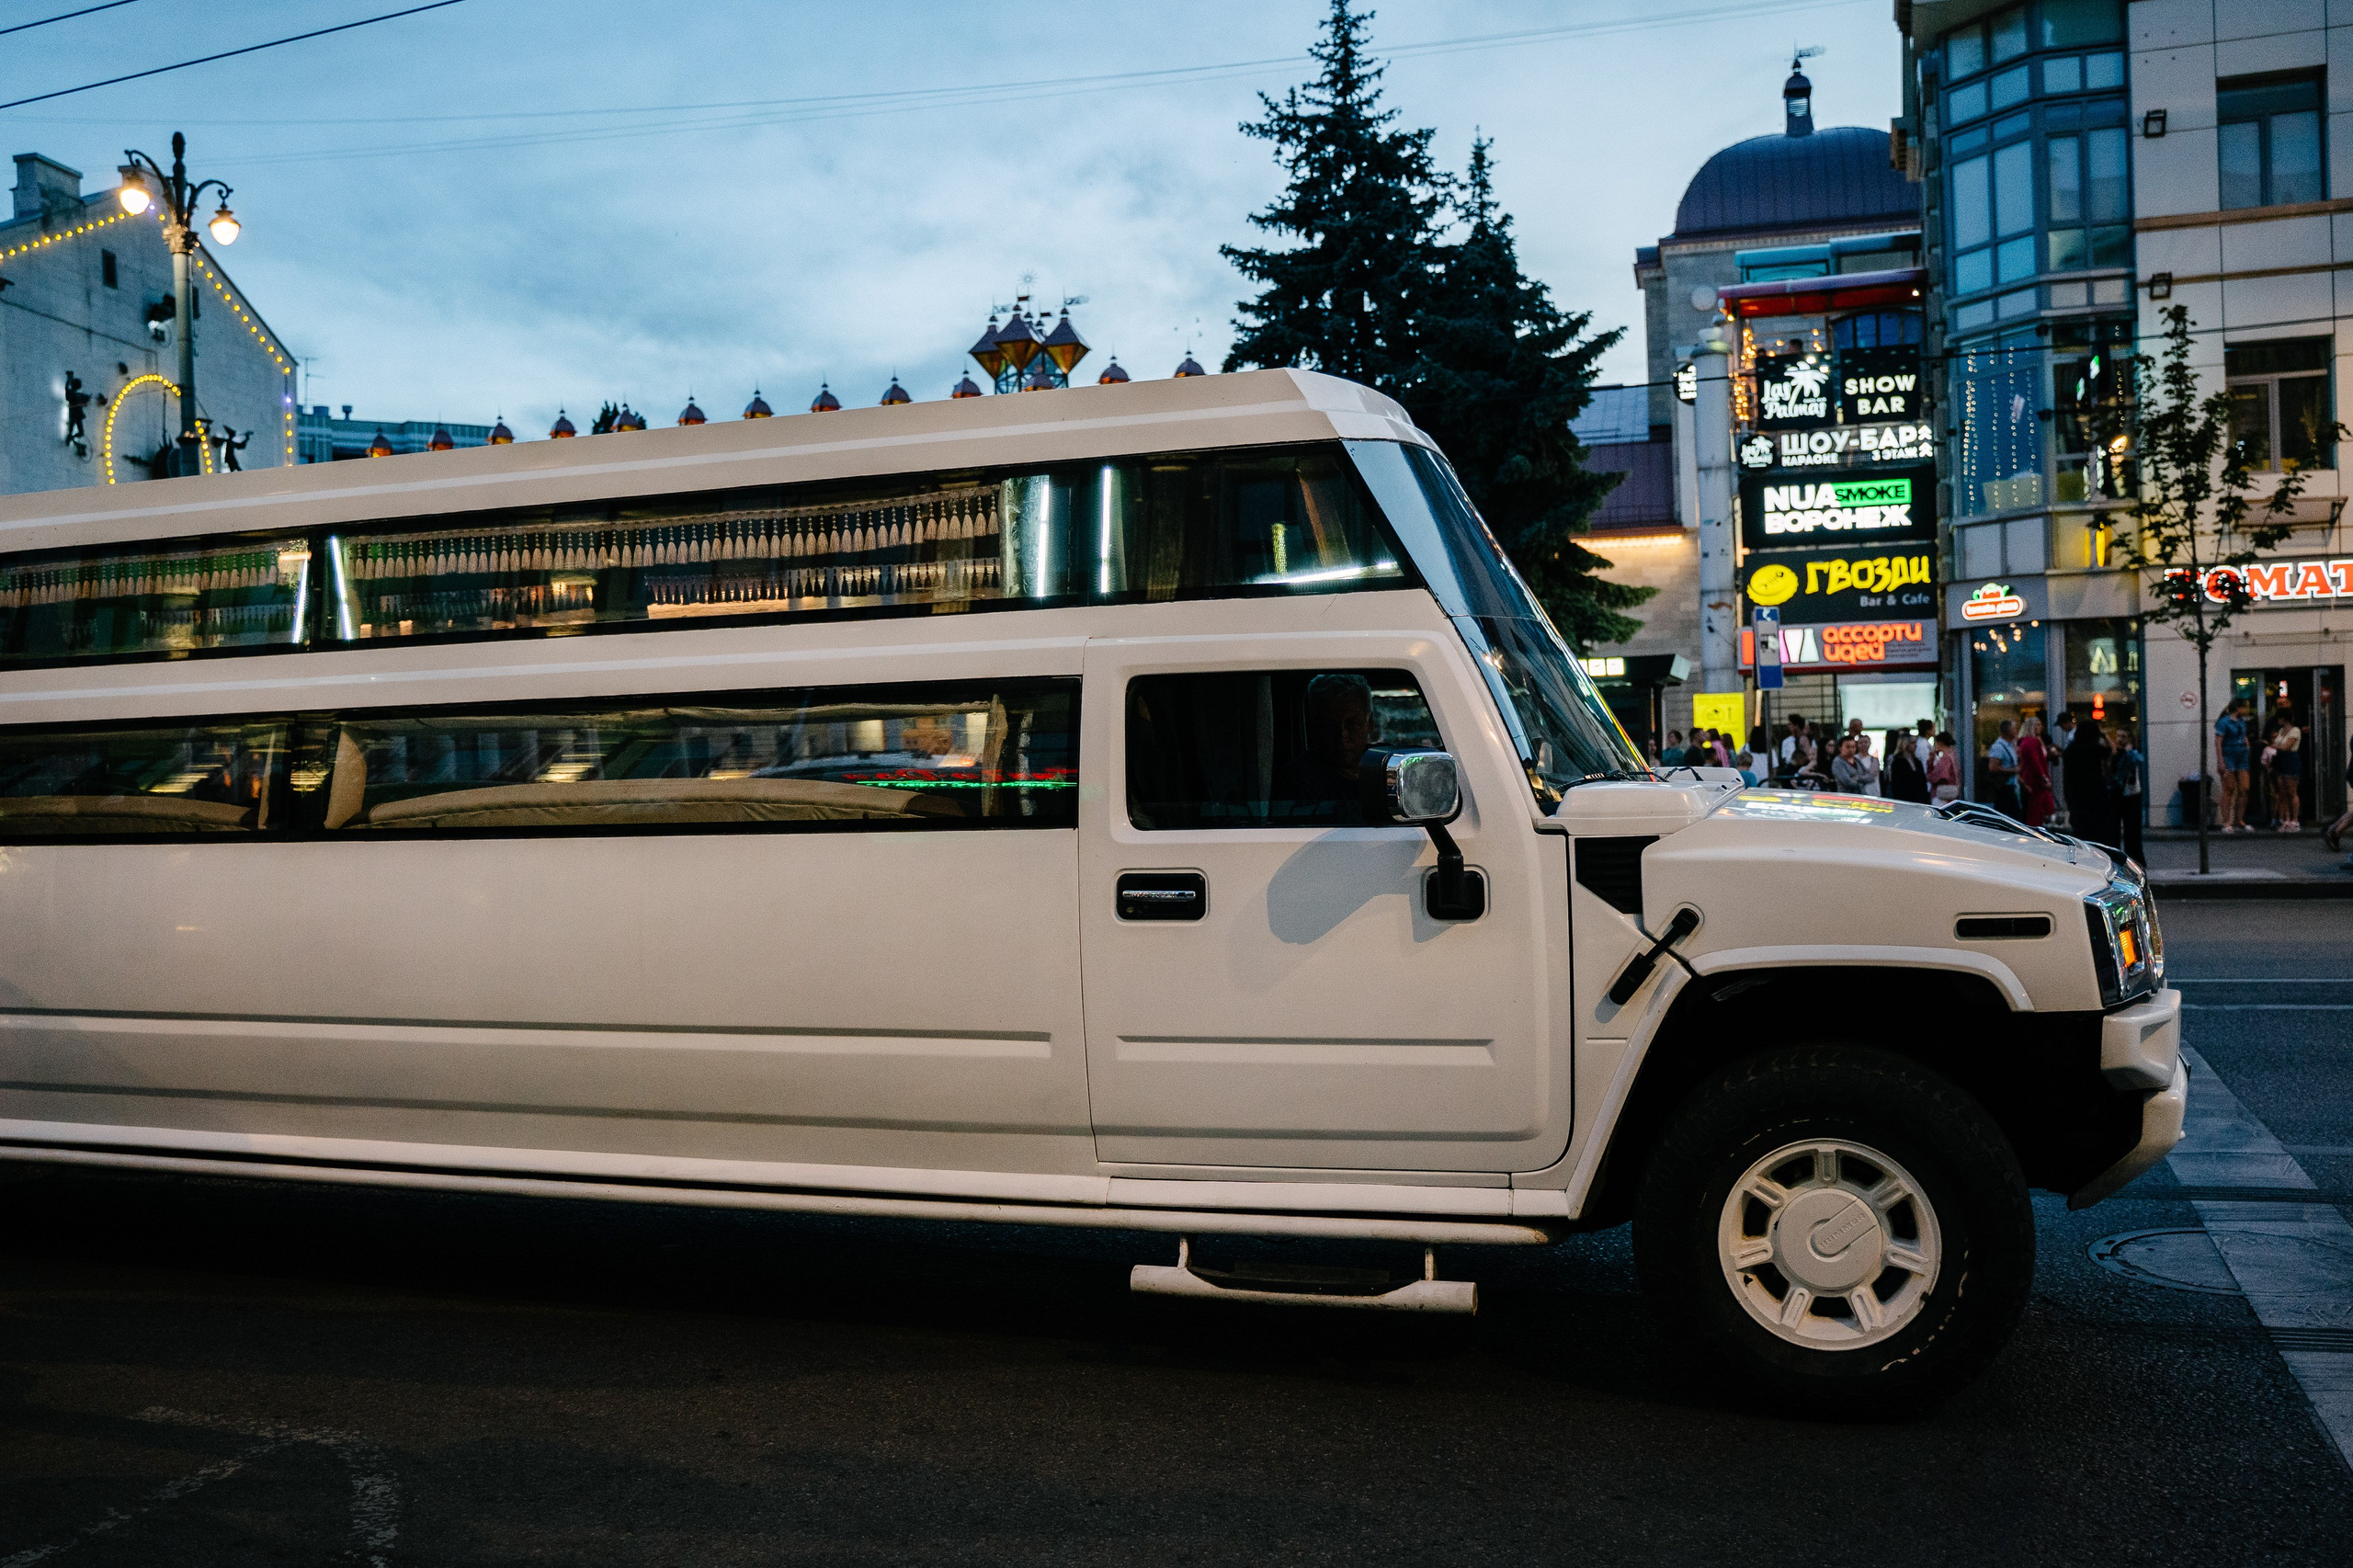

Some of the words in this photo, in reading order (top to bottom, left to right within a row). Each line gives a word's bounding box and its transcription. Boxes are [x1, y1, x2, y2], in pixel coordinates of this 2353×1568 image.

[1760, 380, 1792, 404] Las
[1845, 374, 1916, 395] SHOW
[1763, 401, 1827, 420] Palmas
[1857, 396, 1905, 415] BAR
[1781, 426, 1917, 456] ШОУ-БАР
[1781, 452, 1838, 467] КАРАОКЕ
[1872, 449, 1881, 461] 3
[1881, 447, 1918, 460] ЭТАЖ
[1764, 483, 1841, 512] NUA
[1835, 484, 1905, 502] SMOKE
[1765, 504, 1913, 535] ВОРОНЕЖ
[1805, 555, 1931, 595] ГВОЗДИ
[1859, 595, 1882, 608] Bar
[1886, 594, 1897, 607] &
[1902, 593, 1930, 606] Cafe
